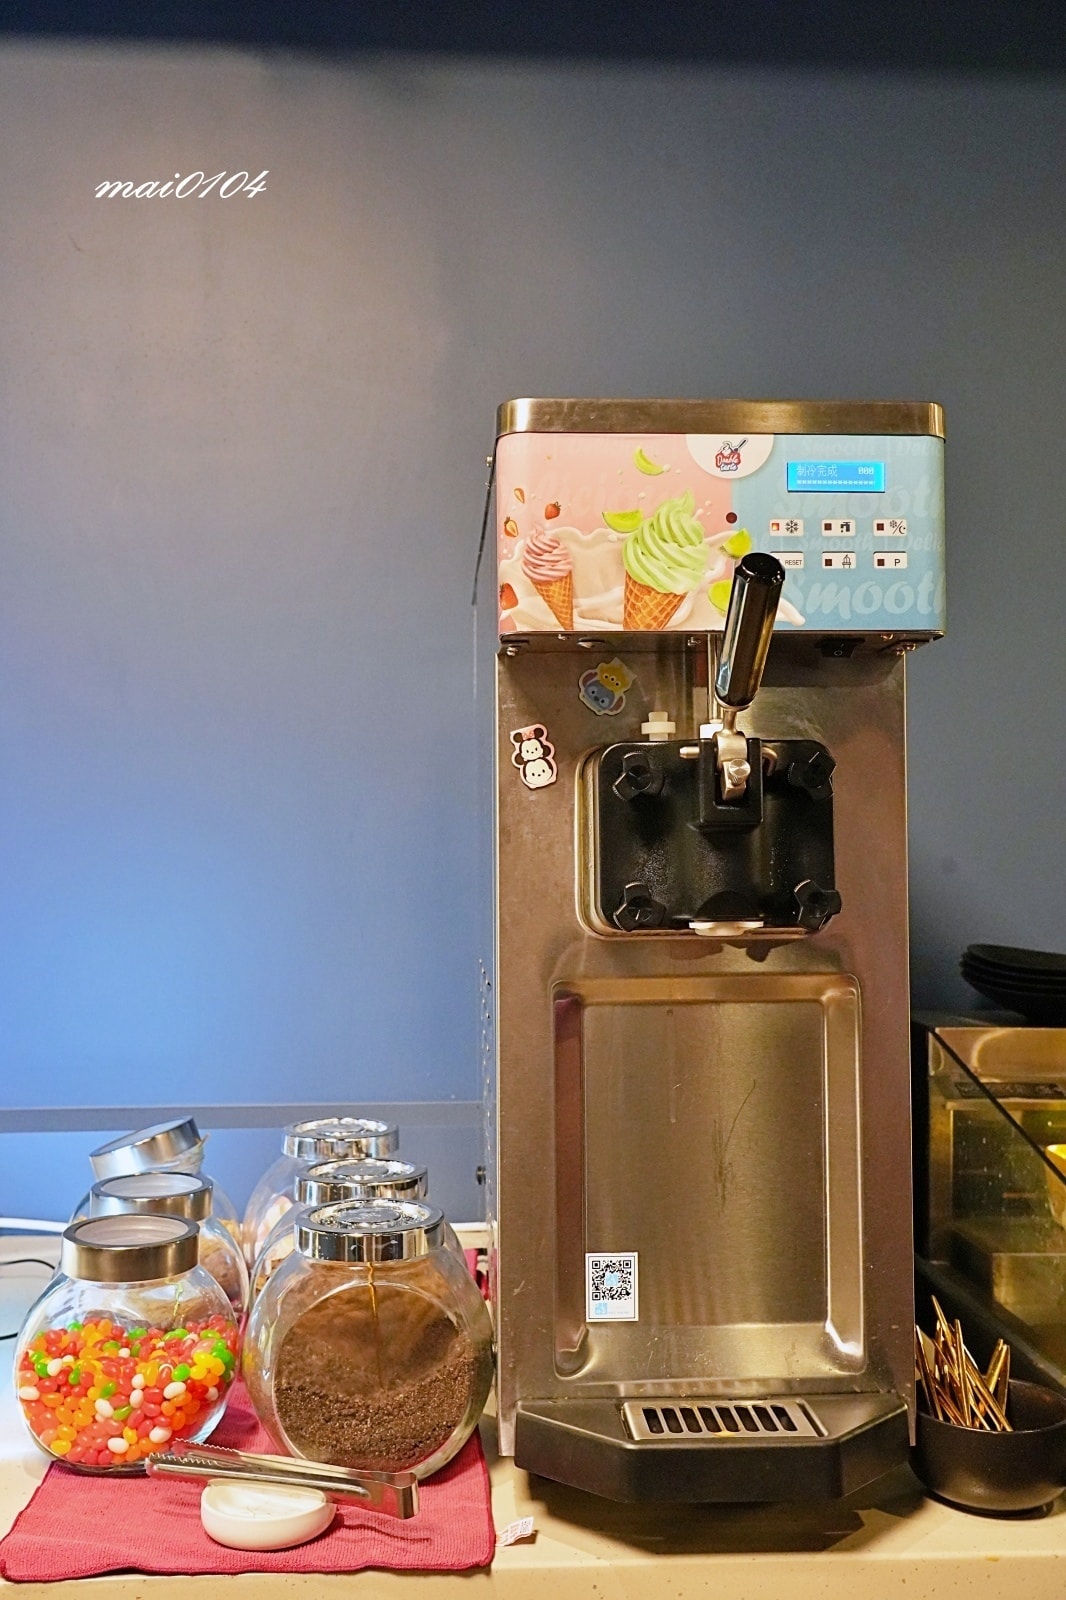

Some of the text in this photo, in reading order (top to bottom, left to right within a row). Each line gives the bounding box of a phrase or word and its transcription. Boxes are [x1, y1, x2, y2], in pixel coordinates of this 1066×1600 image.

[796, 464, 838, 478] 制冷完成
[894, 558, 901, 567] P
